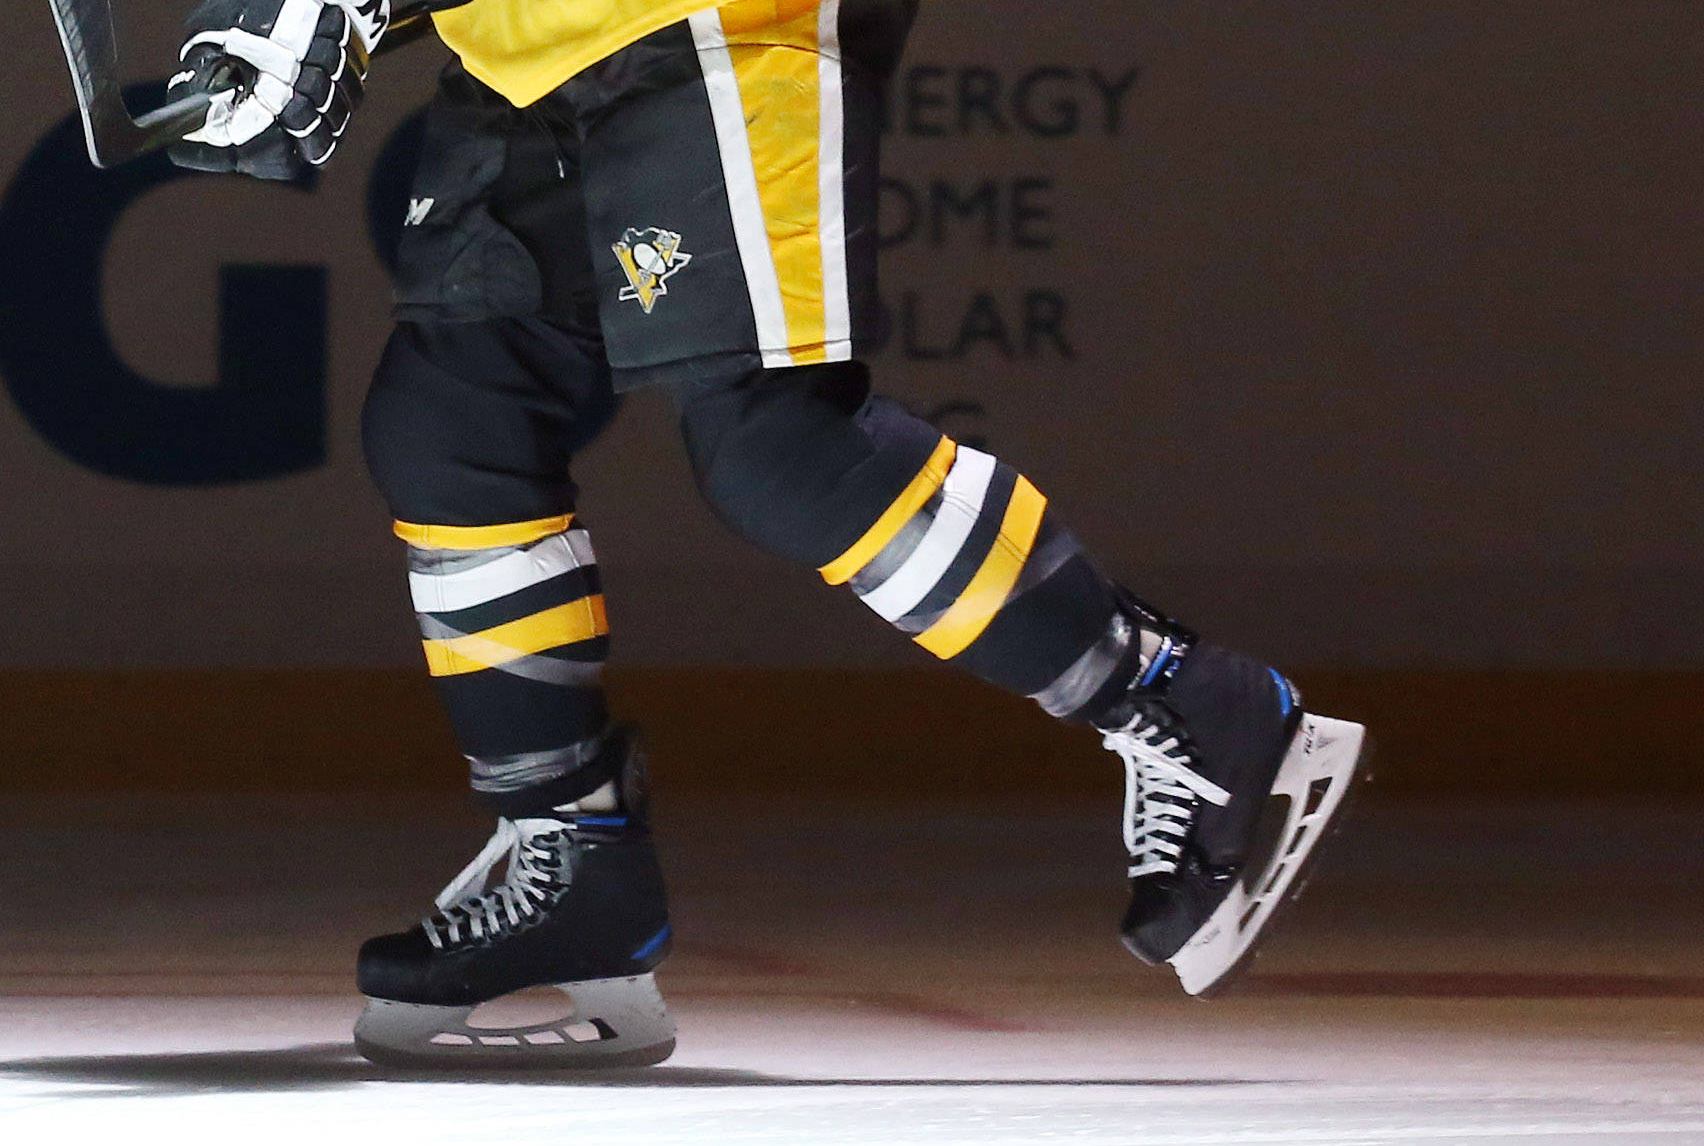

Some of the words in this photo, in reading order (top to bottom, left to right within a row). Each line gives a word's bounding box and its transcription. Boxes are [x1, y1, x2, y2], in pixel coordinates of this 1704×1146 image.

[884, 64, 1142, 137] ERGY
[877, 176, 1052, 250] OME
[884, 288, 1078, 361] LAR
